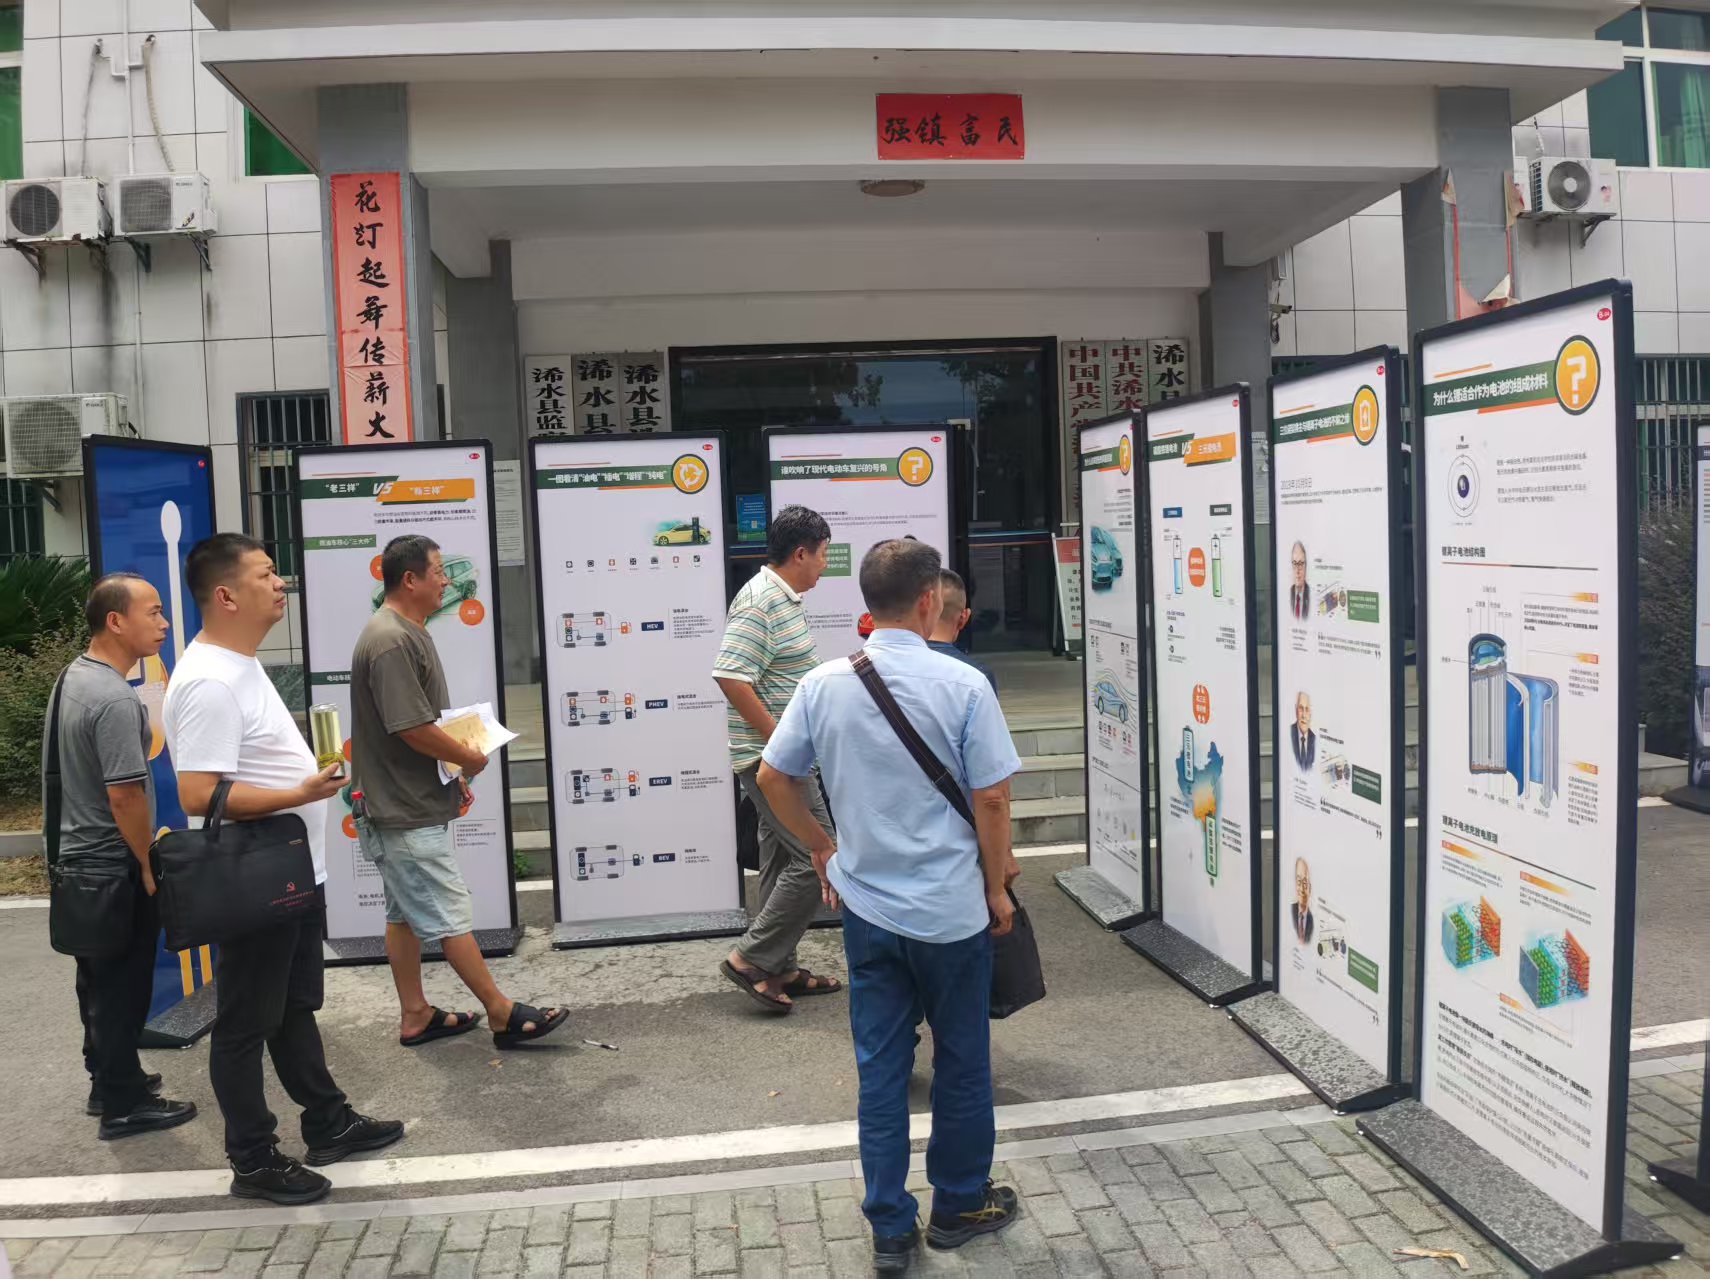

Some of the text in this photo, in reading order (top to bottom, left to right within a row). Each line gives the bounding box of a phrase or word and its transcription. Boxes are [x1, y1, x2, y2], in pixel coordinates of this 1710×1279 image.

[880, 112, 1018, 146] 强镇富民
[353, 180, 395, 439] 花灯起舞传薪火
[531, 366, 568, 436] 浠水县监
[577, 358, 616, 434] 浠水县
[624, 363, 662, 433] 浠水县
[1111, 344, 1144, 411] 中共浠水
[1433, 371, 1548, 406] 为什么锂适合作为电池的组成材料
[372, 482, 394, 495] VS
[781, 463, 888, 475] 谁吹响了现代电动车复兴的号角
[648, 700, 665, 708] PHEV
